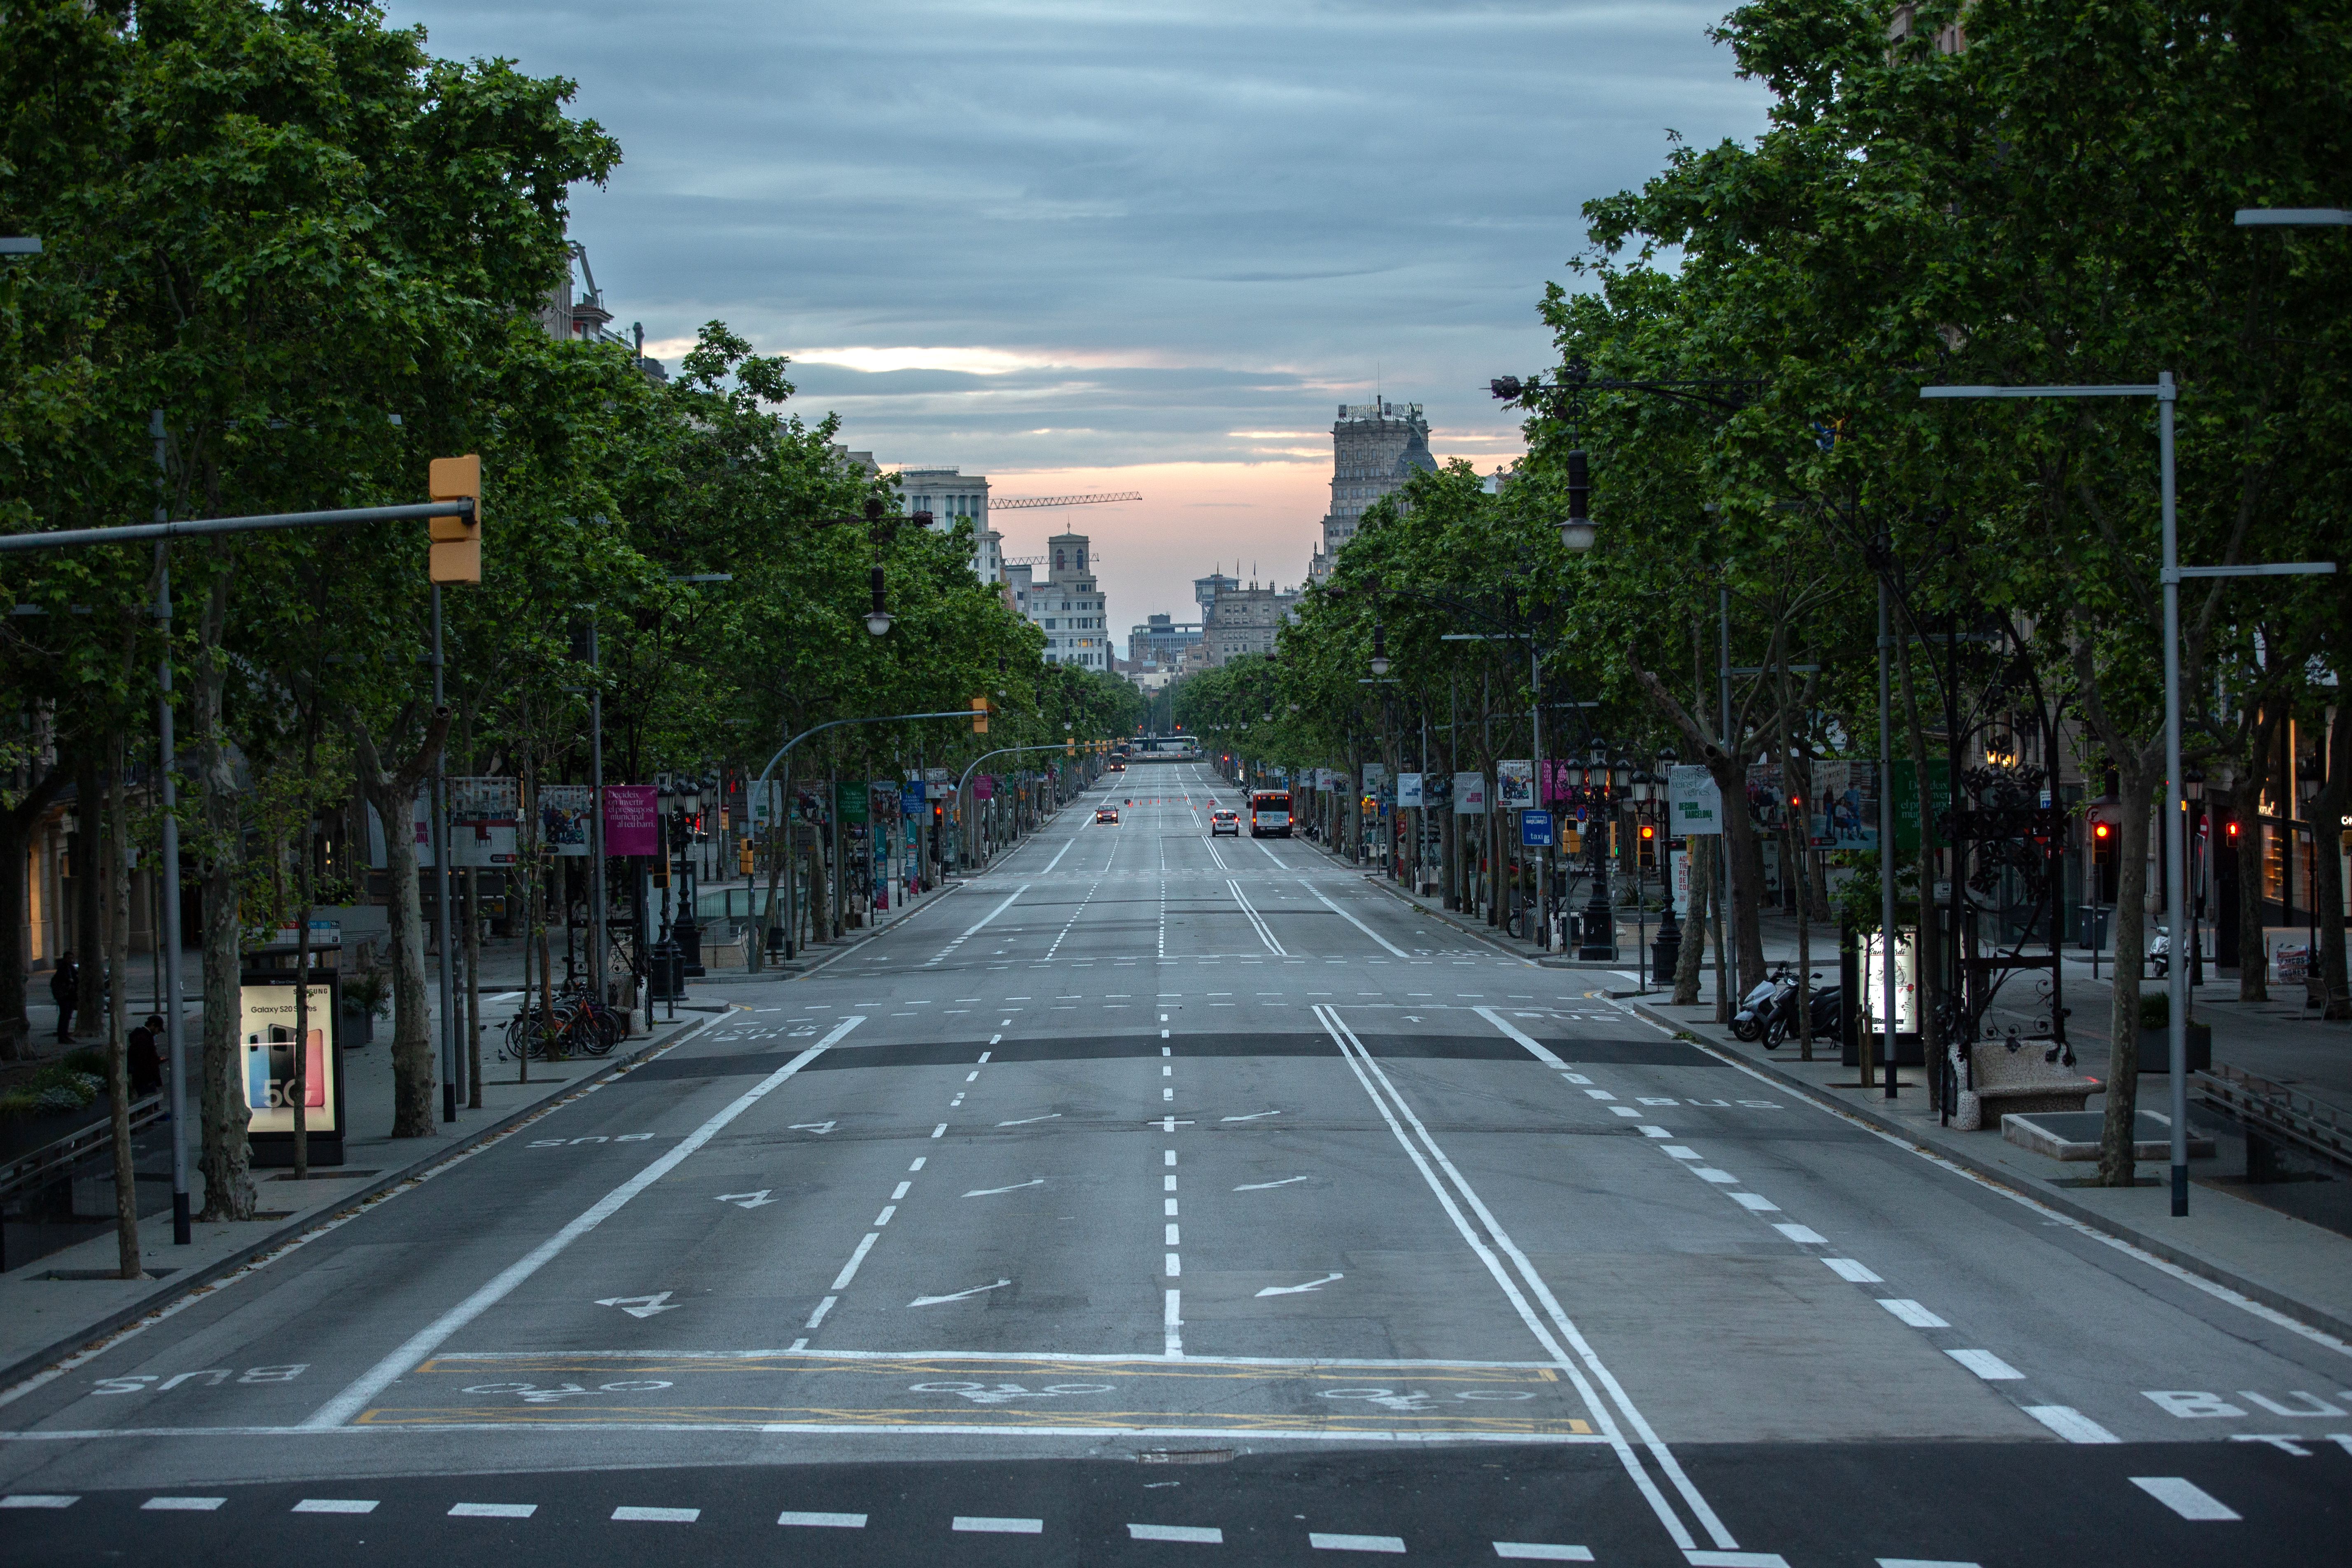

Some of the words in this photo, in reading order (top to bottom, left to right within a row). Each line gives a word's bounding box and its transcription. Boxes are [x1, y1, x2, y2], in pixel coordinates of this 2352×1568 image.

[608, 790, 639, 798] Decideix
[615, 806, 654, 815] pressupost
[1685, 810, 1713, 819] BARCELONA
[610, 812, 644, 822] municipal
[617, 819, 623, 827] al
[636, 819, 655, 827] barri.
[250, 1006, 279, 1014] Galaxy
[1513, 1012, 1621, 1021] BUS
[1635, 1097, 1784, 1109] BUS
[523, 1133, 656, 1148] BUS
[90, 1363, 311, 1396] BUS
